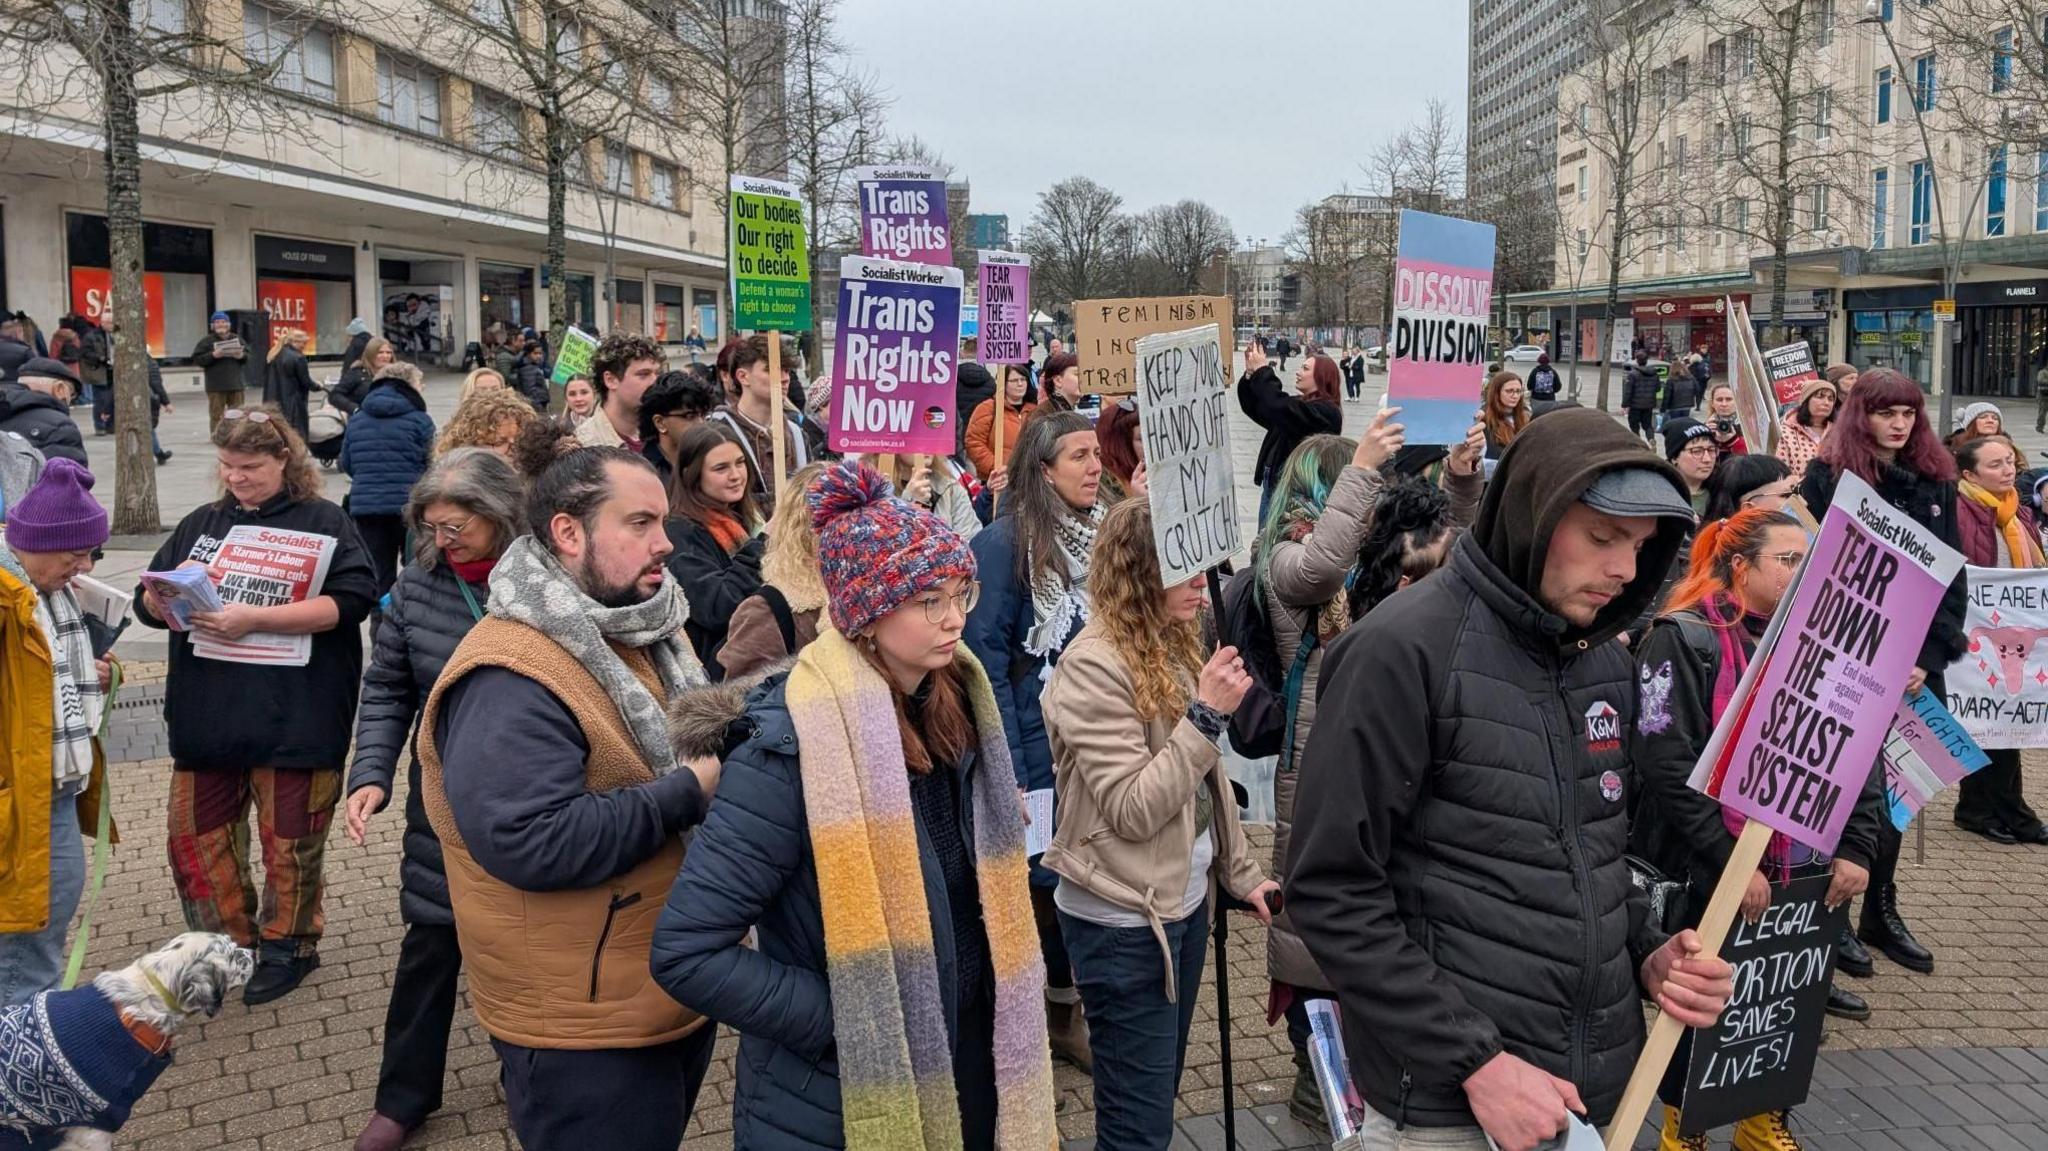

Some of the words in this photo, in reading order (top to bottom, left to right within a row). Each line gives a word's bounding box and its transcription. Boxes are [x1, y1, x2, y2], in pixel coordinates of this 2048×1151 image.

[736, 195, 759, 220] Our
[764, 199, 801, 225] bodies
[863, 182, 929, 215] Trans
[738, 223, 761, 247] Our
[766, 227, 795, 254] right
[871, 218, 947, 258] Rights
[739, 252, 753, 274] to
[757, 253, 798, 277] decide
[986, 266, 1010, 284] TEAR
[740, 282, 767, 296] Defend
[768, 287, 774, 297] a
[775, 285, 804, 298] woman's
[986, 285, 1014, 303] DOWN
[1396, 267, 1491, 319] DISSOLVE
[2006, 287, 2036, 296] FLANNELS
[264, 296, 307, 322] SALE
[739, 299, 760, 315] right
[762, 300, 770, 313] to
[771, 300, 796, 313] choose
[845, 281, 935, 334] Trans
[986, 303, 1003, 321] THE
[1102, 300, 1215, 323] FEMINISM
[986, 323, 1017, 341] SEXIST
[1395, 316, 1488, 366] DIVISION
[845, 333, 951, 392] Rights
[985, 341, 1022, 360] SYSTEM
[1770, 350, 1806, 367] FREEDOM
[1144, 347, 1182, 407] KEEP
[1189, 340, 1226, 393] YOUR
[1772, 362, 1813, 380] PALESTINE
[841, 385, 915, 433] Now
[1146, 399, 1200, 463] HANDS
[1203, 391, 1225, 449] OFF
[1180, 455, 1208, 513] MY
[258, 531, 324, 551] Socialist
[1164, 484, 1239, 574] CRUTCH!
[218, 557, 259, 574] threatens
[260, 563, 286, 578] more
[287, 569, 310, 583] cuts
[230, 546, 276, 563] Starmer's
[274, 552, 306, 568] Labour
[1830, 522, 1899, 607] TEAR
[217, 585, 239, 604] PAY
[239, 590, 264, 607] FOR
[263, 594, 291, 606] THE
[224, 571, 244, 588] WE
[247, 577, 291, 597] WON'T
[1999, 585, 2038, 609] ARE
[1806, 578, 1890, 667] DOWN
[1784, 631, 1836, 702] THE
[1841, 661, 1860, 681] End
[1859, 668, 1886, 698] violence
[1834, 680, 1864, 706] against
[1827, 698, 1854, 721] women
[1760, 688, 1854, 775] SEXIST
[1907, 695, 1970, 758] RIGHTS
[1738, 742, 1842, 835] SYSTEM
[1734, 900, 1820, 947] LEGAL
[1720, 996, 1796, 1042] SAVES
[1699, 1031, 1794, 1090] LIVES!
